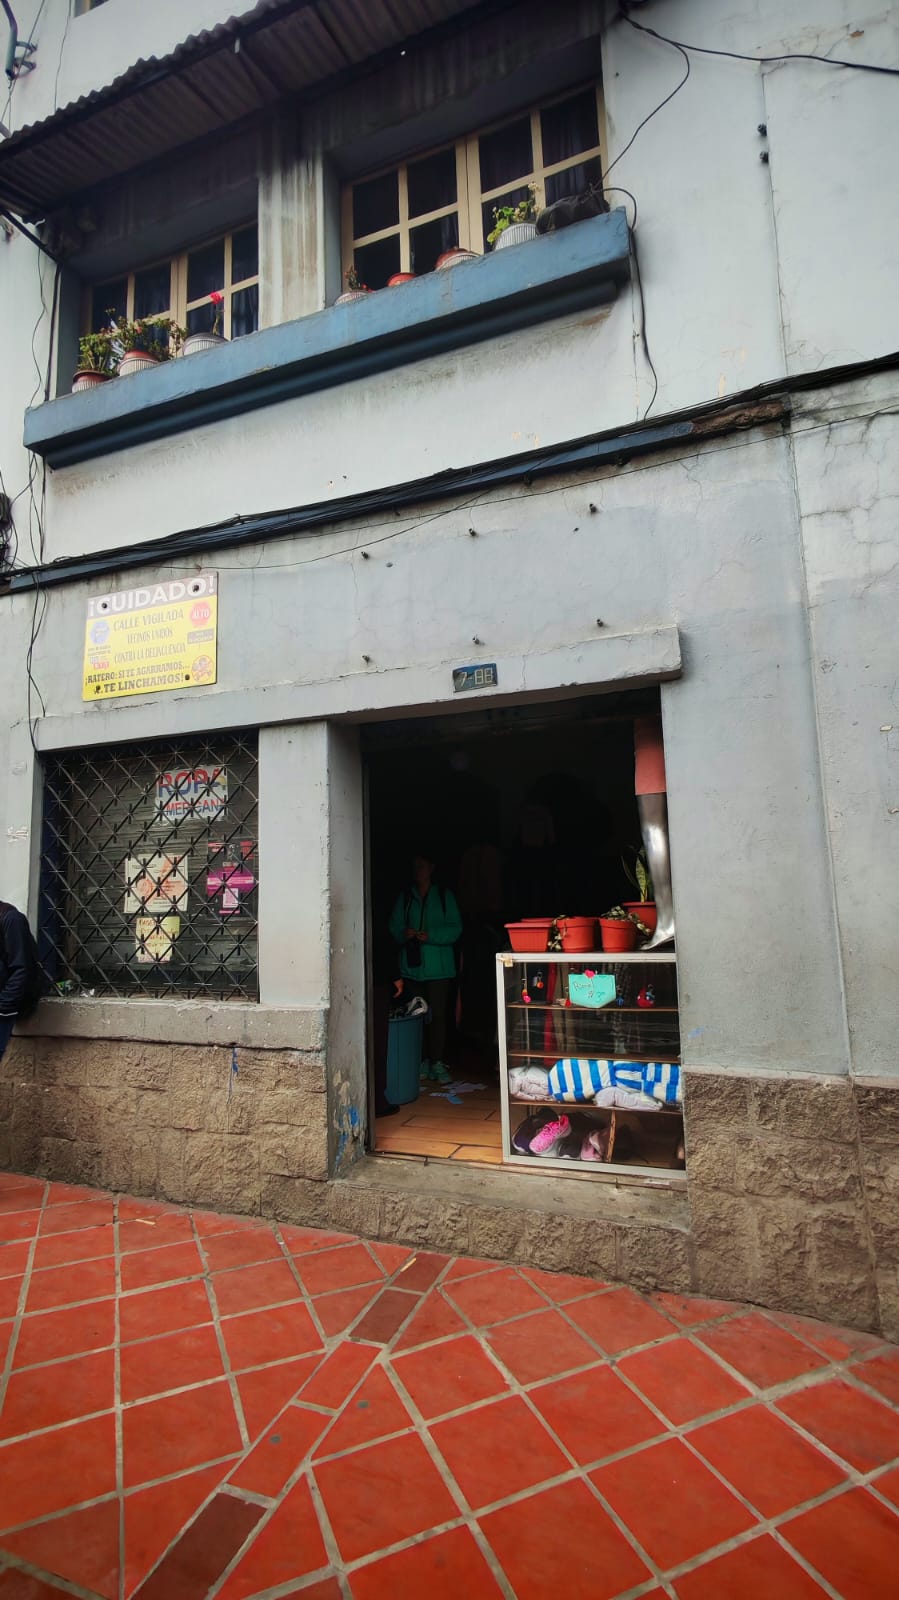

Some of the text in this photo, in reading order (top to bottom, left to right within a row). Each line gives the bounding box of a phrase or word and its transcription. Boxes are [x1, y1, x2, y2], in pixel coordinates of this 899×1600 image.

[88, 575, 215, 617] ¡CUIDADO!
[113, 608, 184, 631] CALLE VIGILADA
[118, 670, 126, 679] SI
[126, 668, 135, 677] TE
[118, 673, 184, 691] LINCHAMOS!
